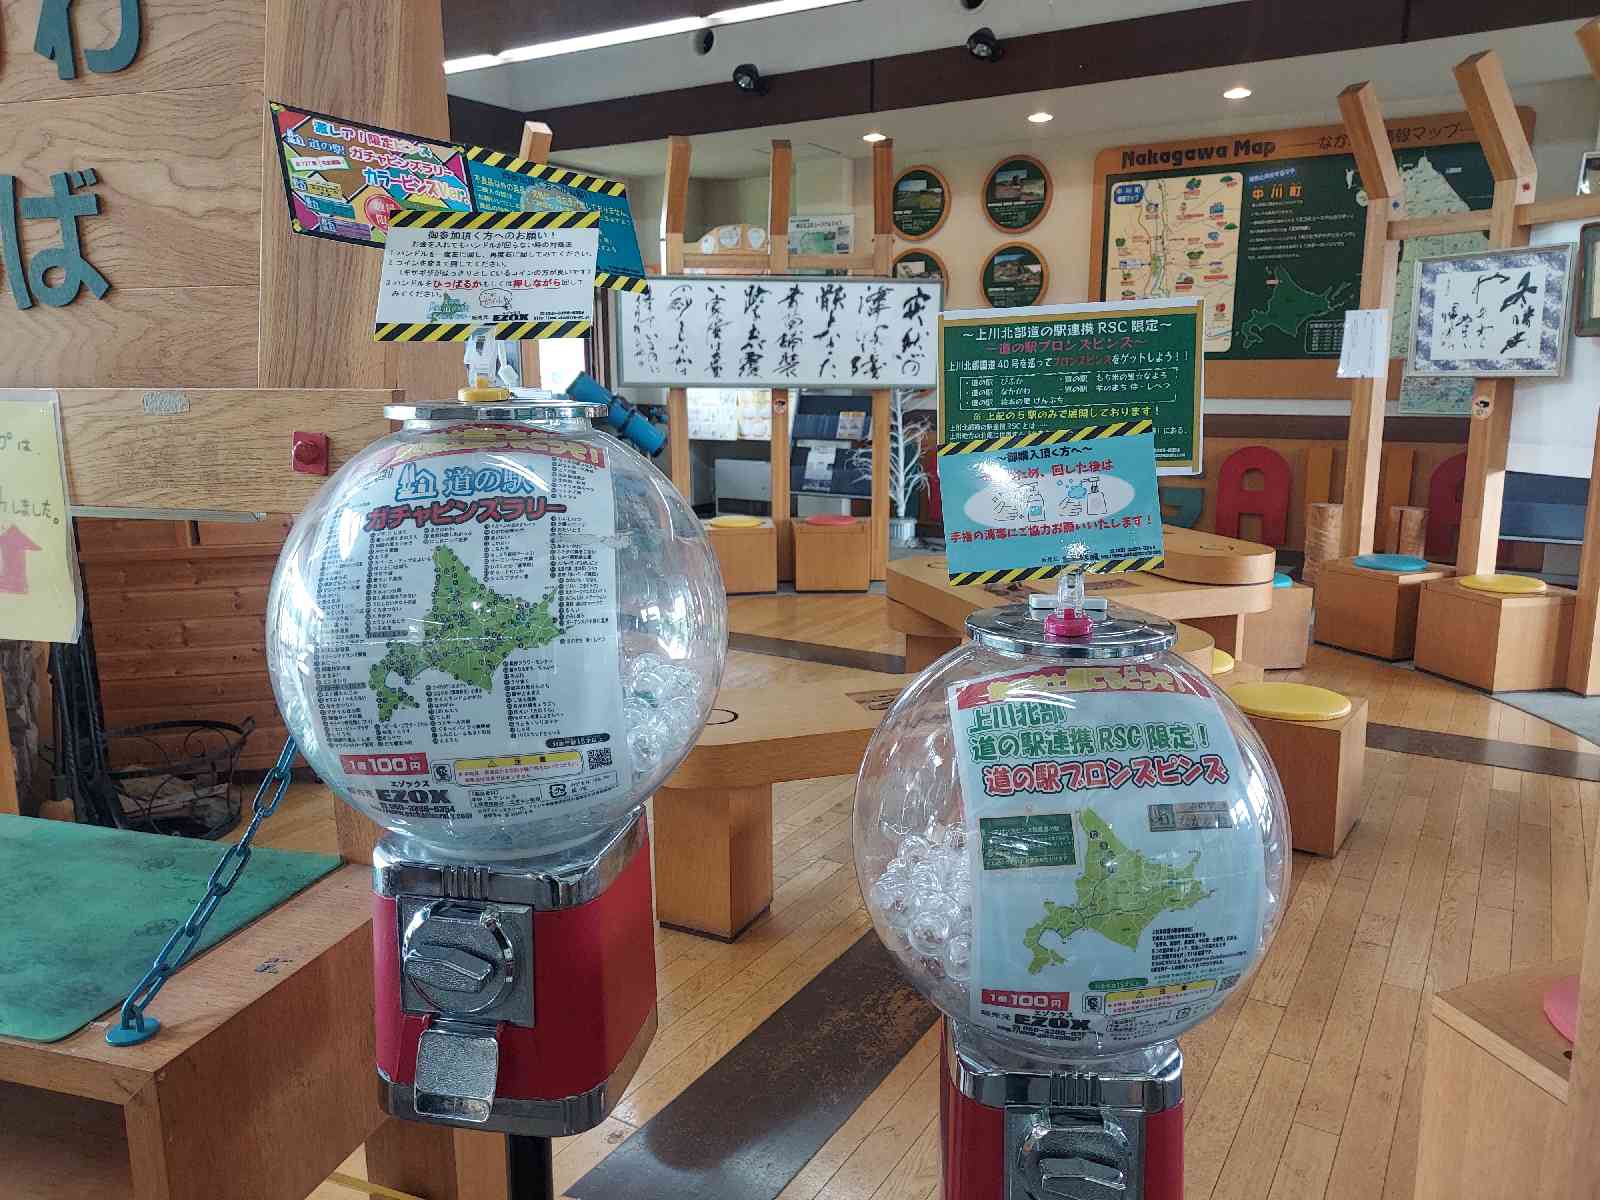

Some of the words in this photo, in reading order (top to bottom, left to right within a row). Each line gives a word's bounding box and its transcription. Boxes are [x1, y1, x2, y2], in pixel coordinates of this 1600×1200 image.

[1120, 143, 1229, 169] Nakagawa
[1233, 139, 1277, 159] Map
[0, 168, 111, 310] ば
[443, 464, 535, 497] 道の駅
[363, 495, 567, 532] ガチャピンズラリー
[982, 755, 1230, 796] 道の駅ブロンズピンズ
[375, 789, 450, 804] EZOX
[1014, 1014, 1091, 1030] EZOX
